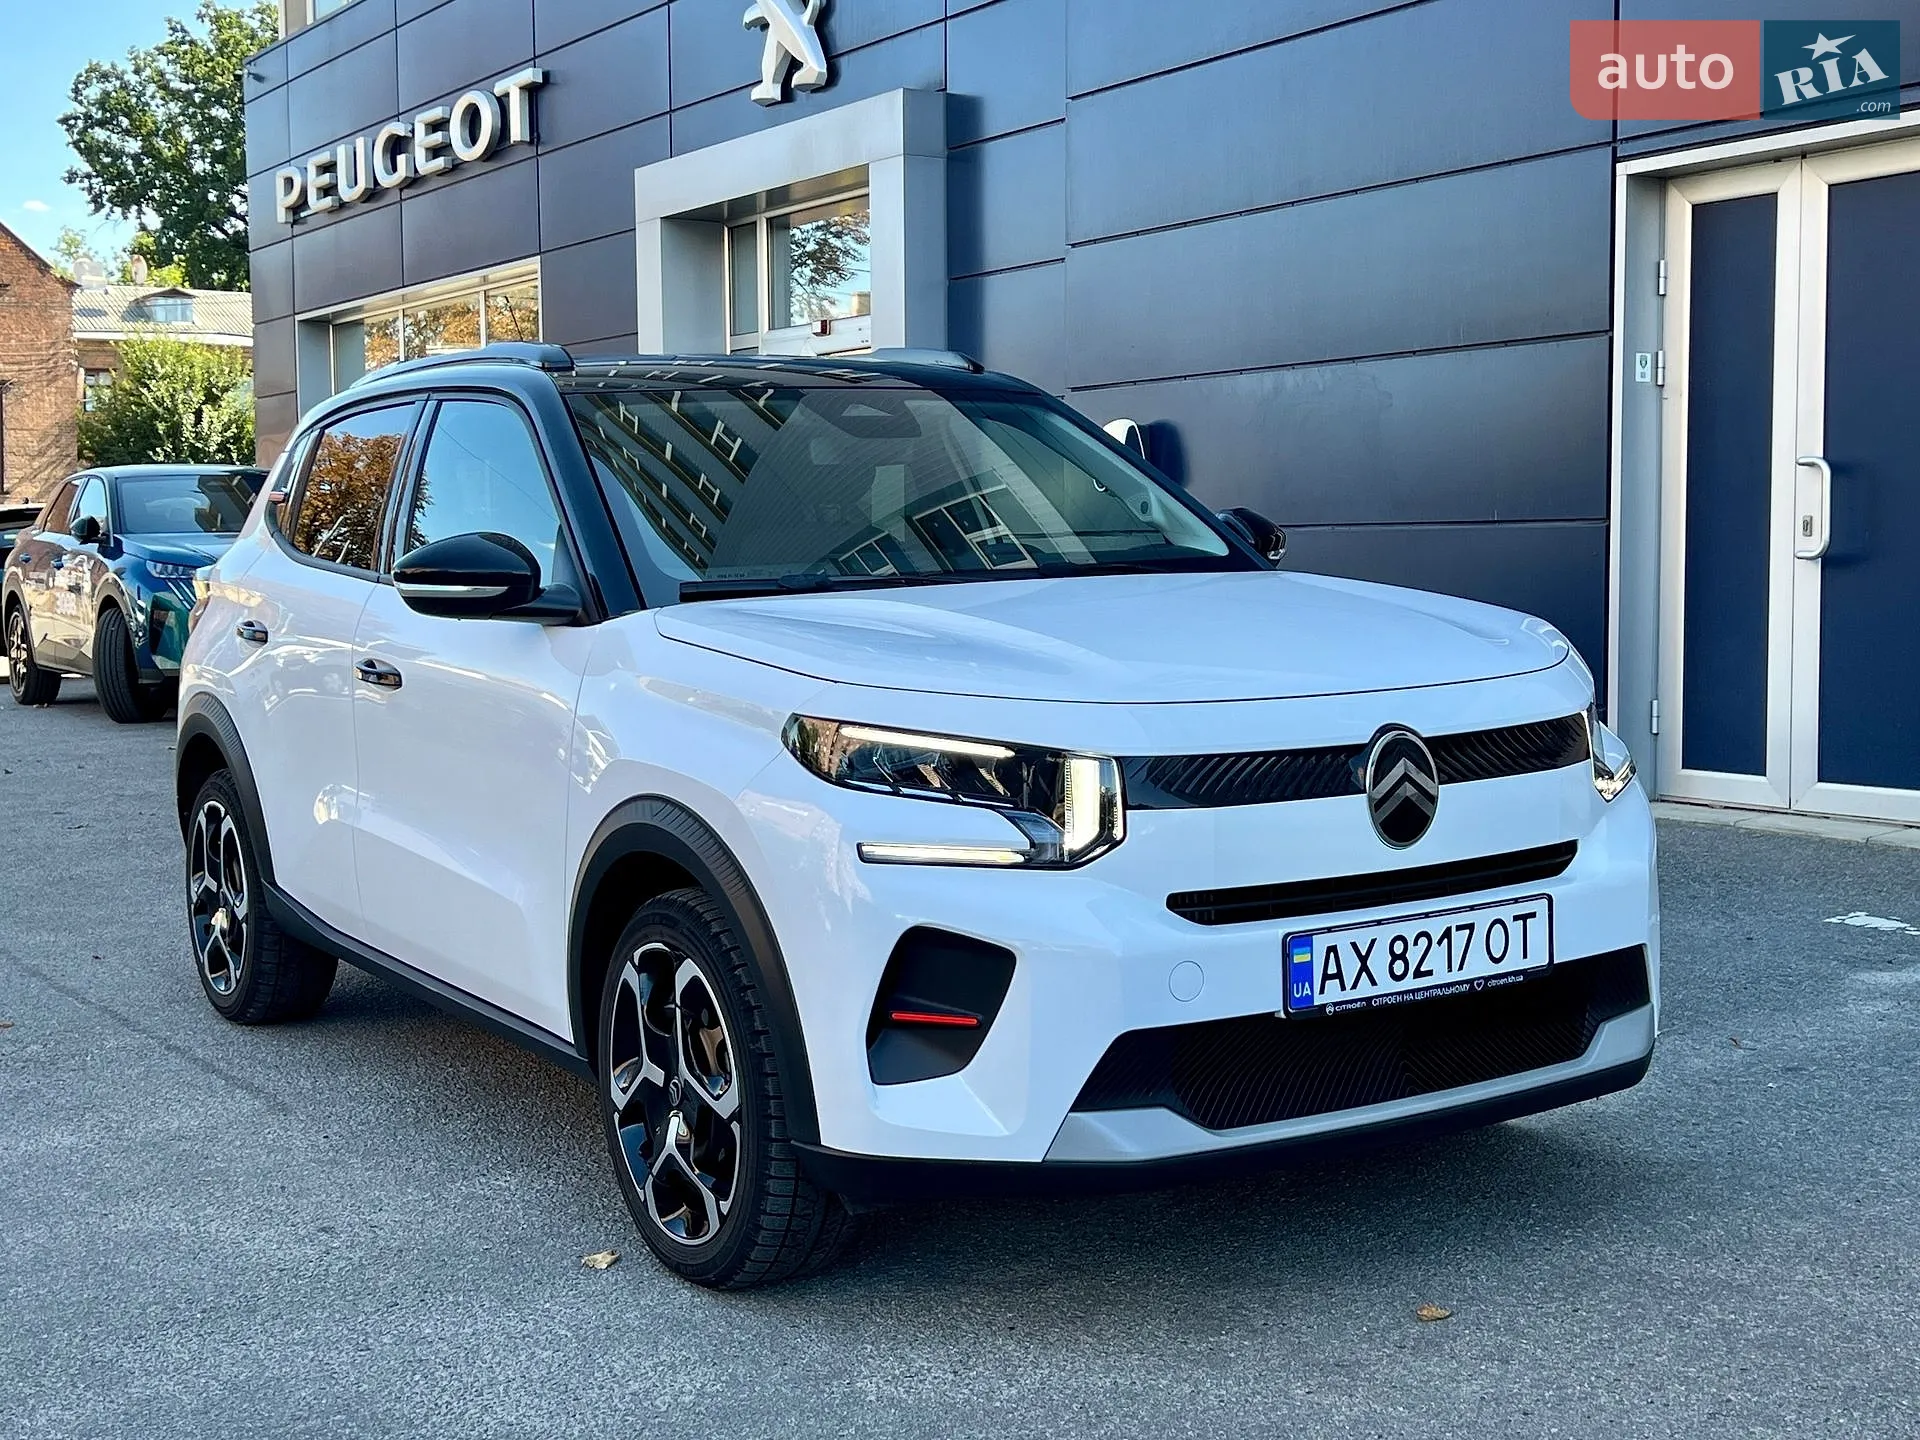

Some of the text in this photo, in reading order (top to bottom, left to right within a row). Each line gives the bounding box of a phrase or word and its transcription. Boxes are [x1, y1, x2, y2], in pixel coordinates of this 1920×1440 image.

[275, 67, 544, 225] PEUGEOT
[1293, 982, 1312, 999] UA
[1318, 911, 1538, 996] AX 8217 OT
